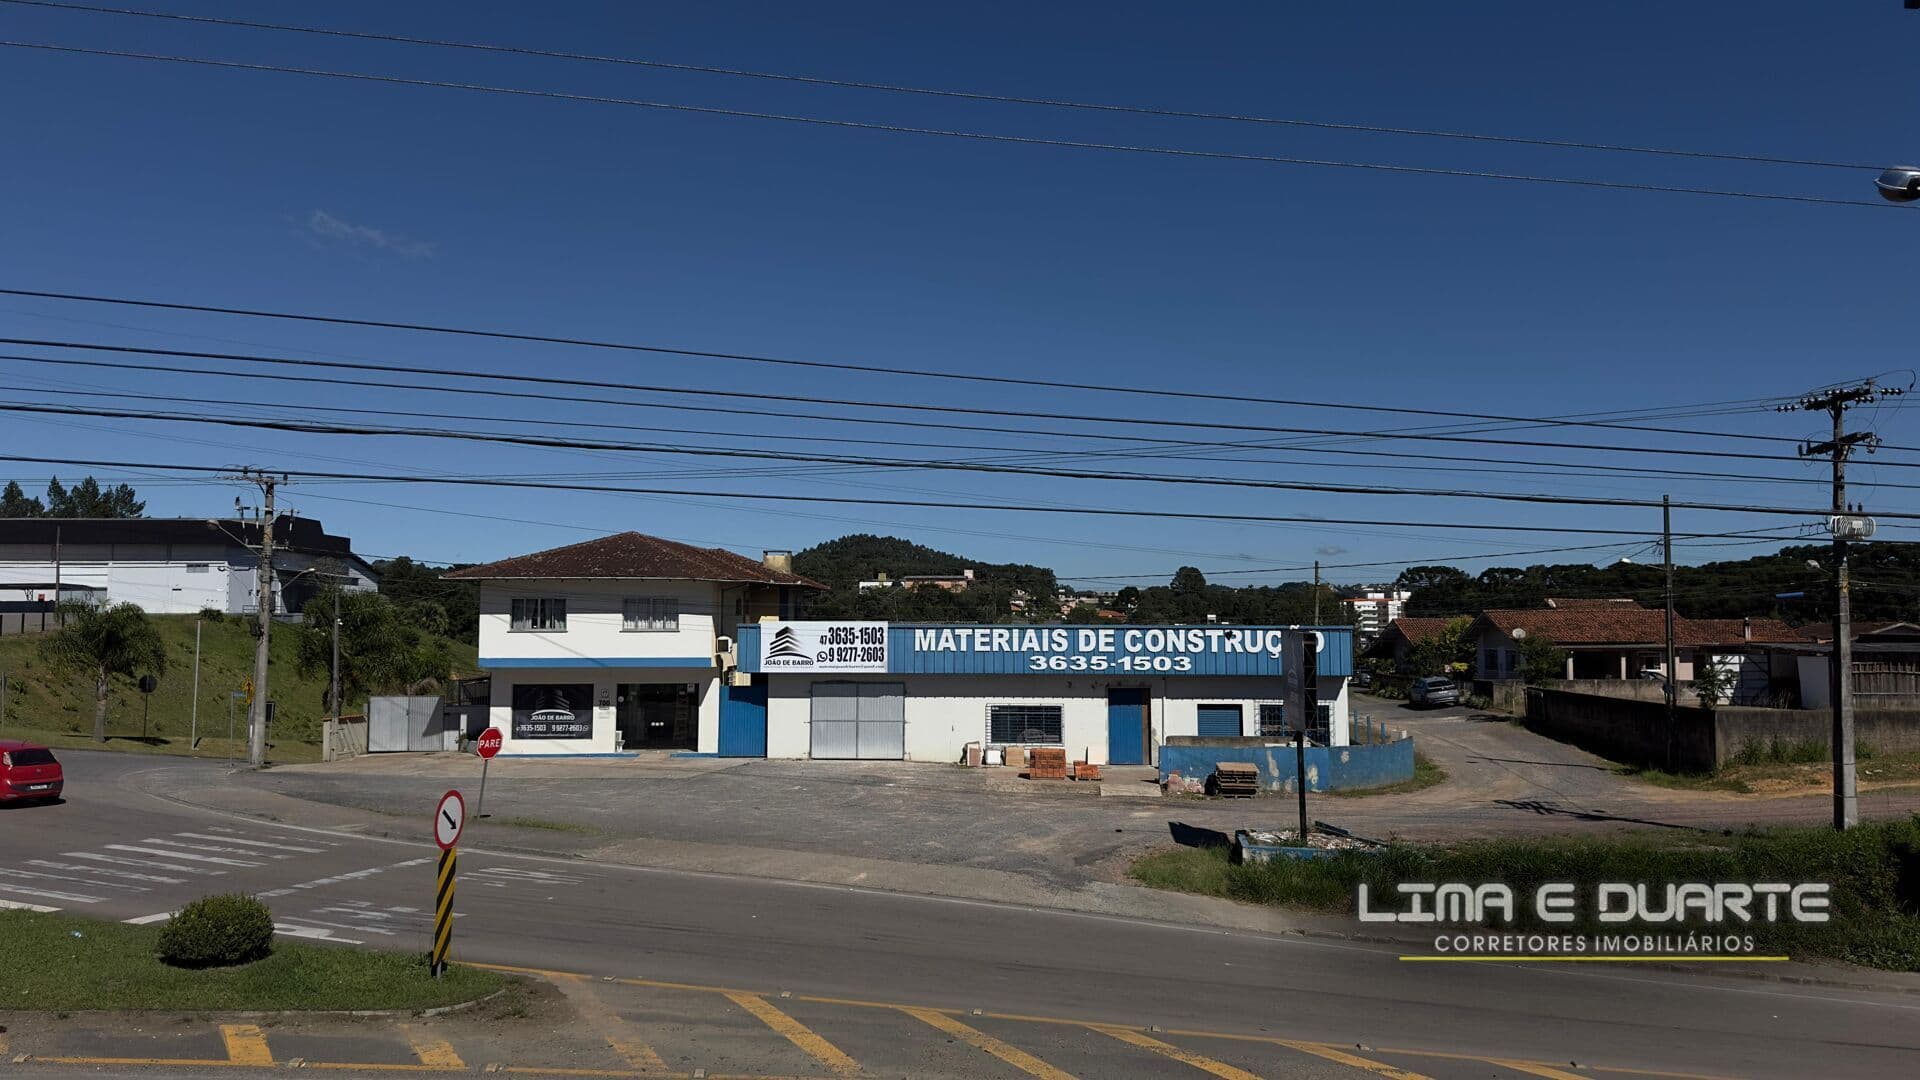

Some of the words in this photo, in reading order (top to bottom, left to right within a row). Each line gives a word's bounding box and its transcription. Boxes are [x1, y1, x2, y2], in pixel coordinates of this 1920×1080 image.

[828, 627, 884, 645] 3635-1503
[914, 629, 1069, 652] MATERIAIS
[1083, 629, 1115, 652] DE
[1124, 624, 1325, 659] CONSTRUÇ
[828, 647, 835, 662] 9
[836, 647, 885, 662] 9277-2603
[1029, 655, 1192, 671] 3635-1503
[479, 738, 501, 748] PARE
